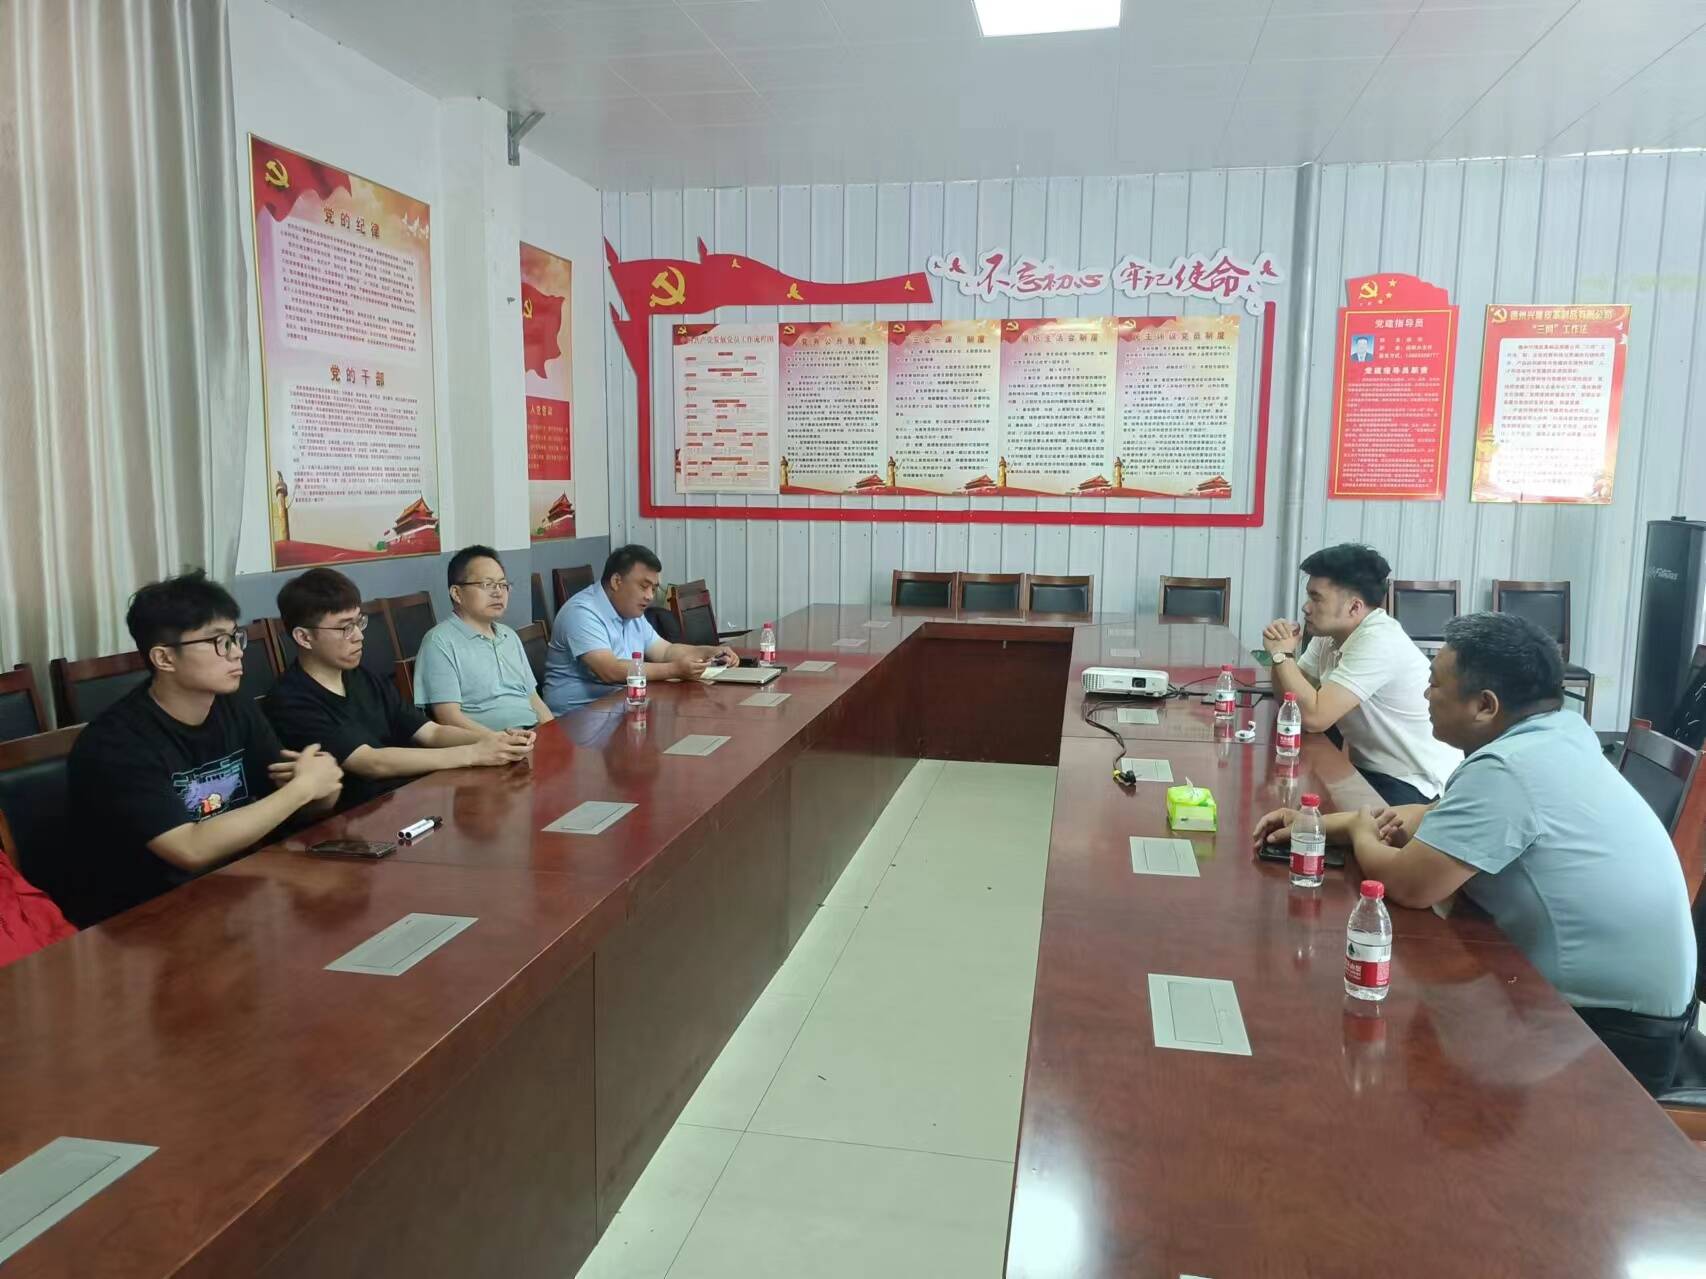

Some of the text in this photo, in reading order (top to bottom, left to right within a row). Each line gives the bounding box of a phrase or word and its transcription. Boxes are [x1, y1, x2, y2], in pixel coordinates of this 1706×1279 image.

[323, 206, 380, 239] 党的纪律
[977, 253, 1250, 297] 不忘初心 牢记使命
[1375, 318, 1424, 328] 党建指导员
[330, 364, 385, 387] 党的干部
